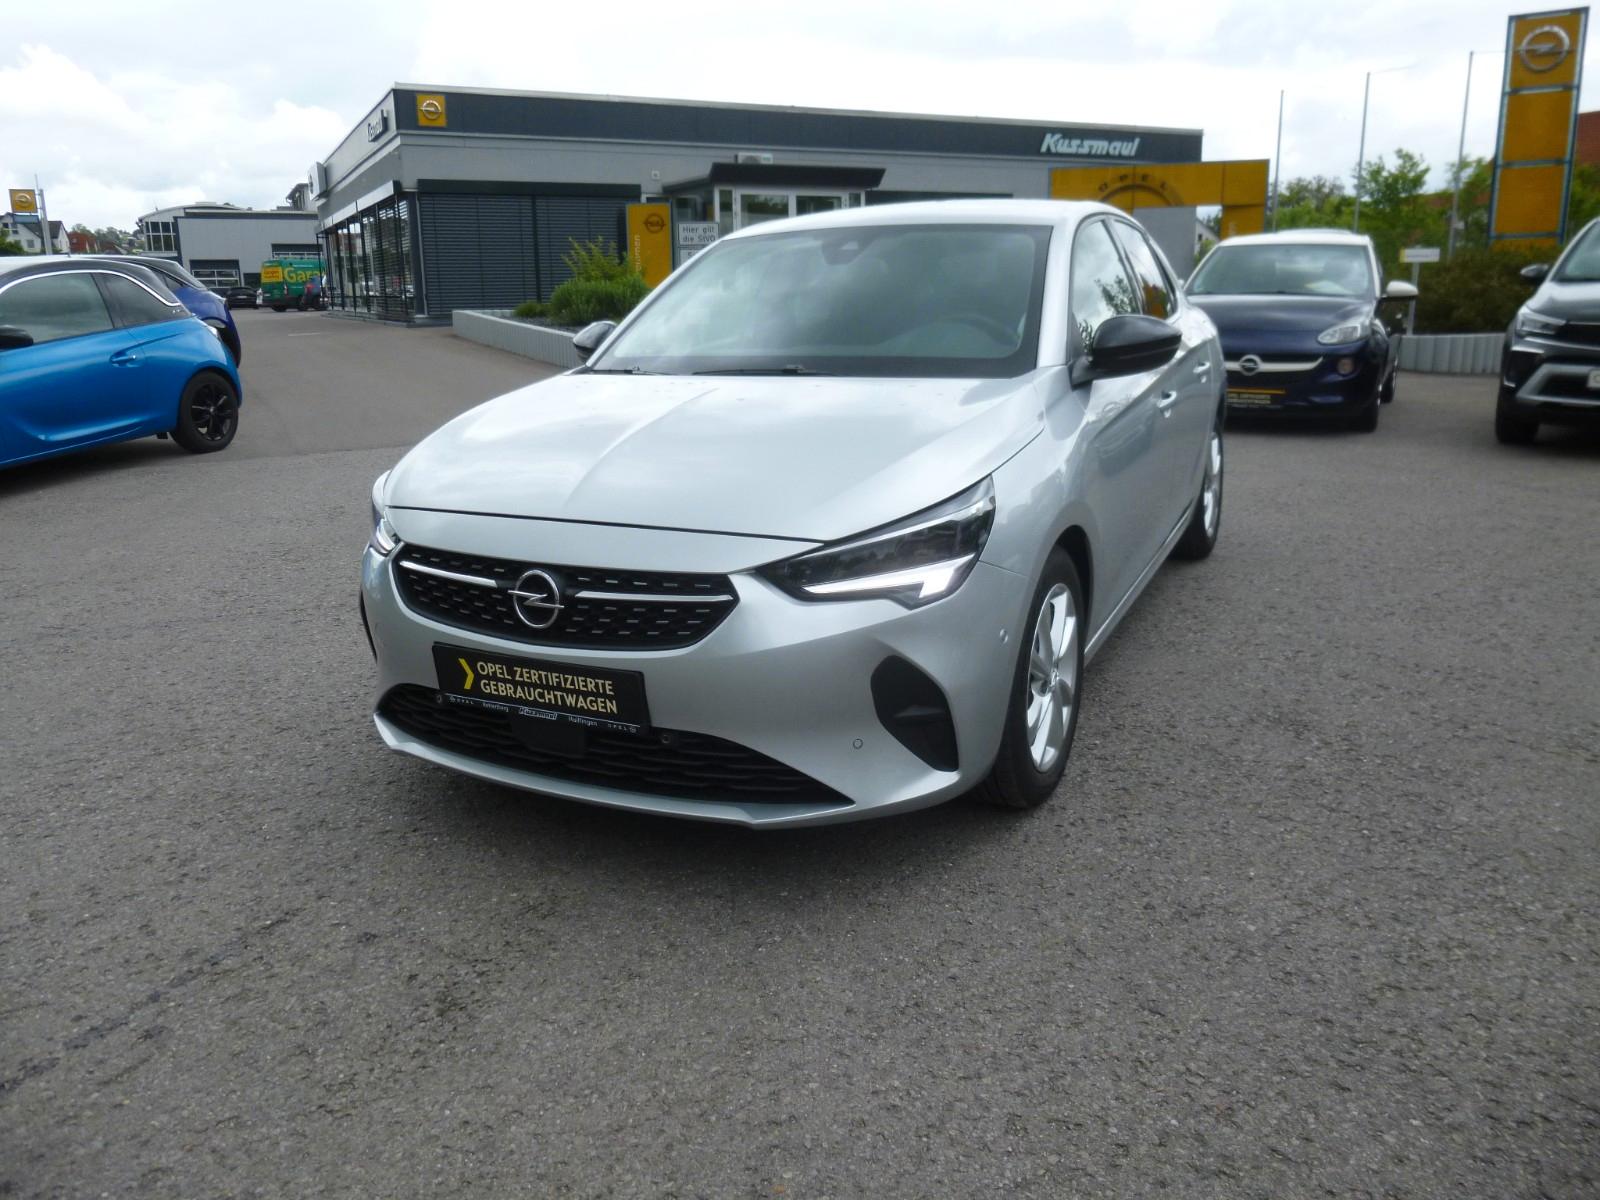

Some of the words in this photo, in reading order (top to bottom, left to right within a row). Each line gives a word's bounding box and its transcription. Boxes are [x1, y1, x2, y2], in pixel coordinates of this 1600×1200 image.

[1040, 133, 1141, 157] Kussmaul
[702, 226, 715, 234] gilt
[477, 661, 512, 680] OPEL
[514, 666, 615, 695] ZERTIFIZIERTE
[480, 679, 618, 714] GEBRAUCHTWAGEN
